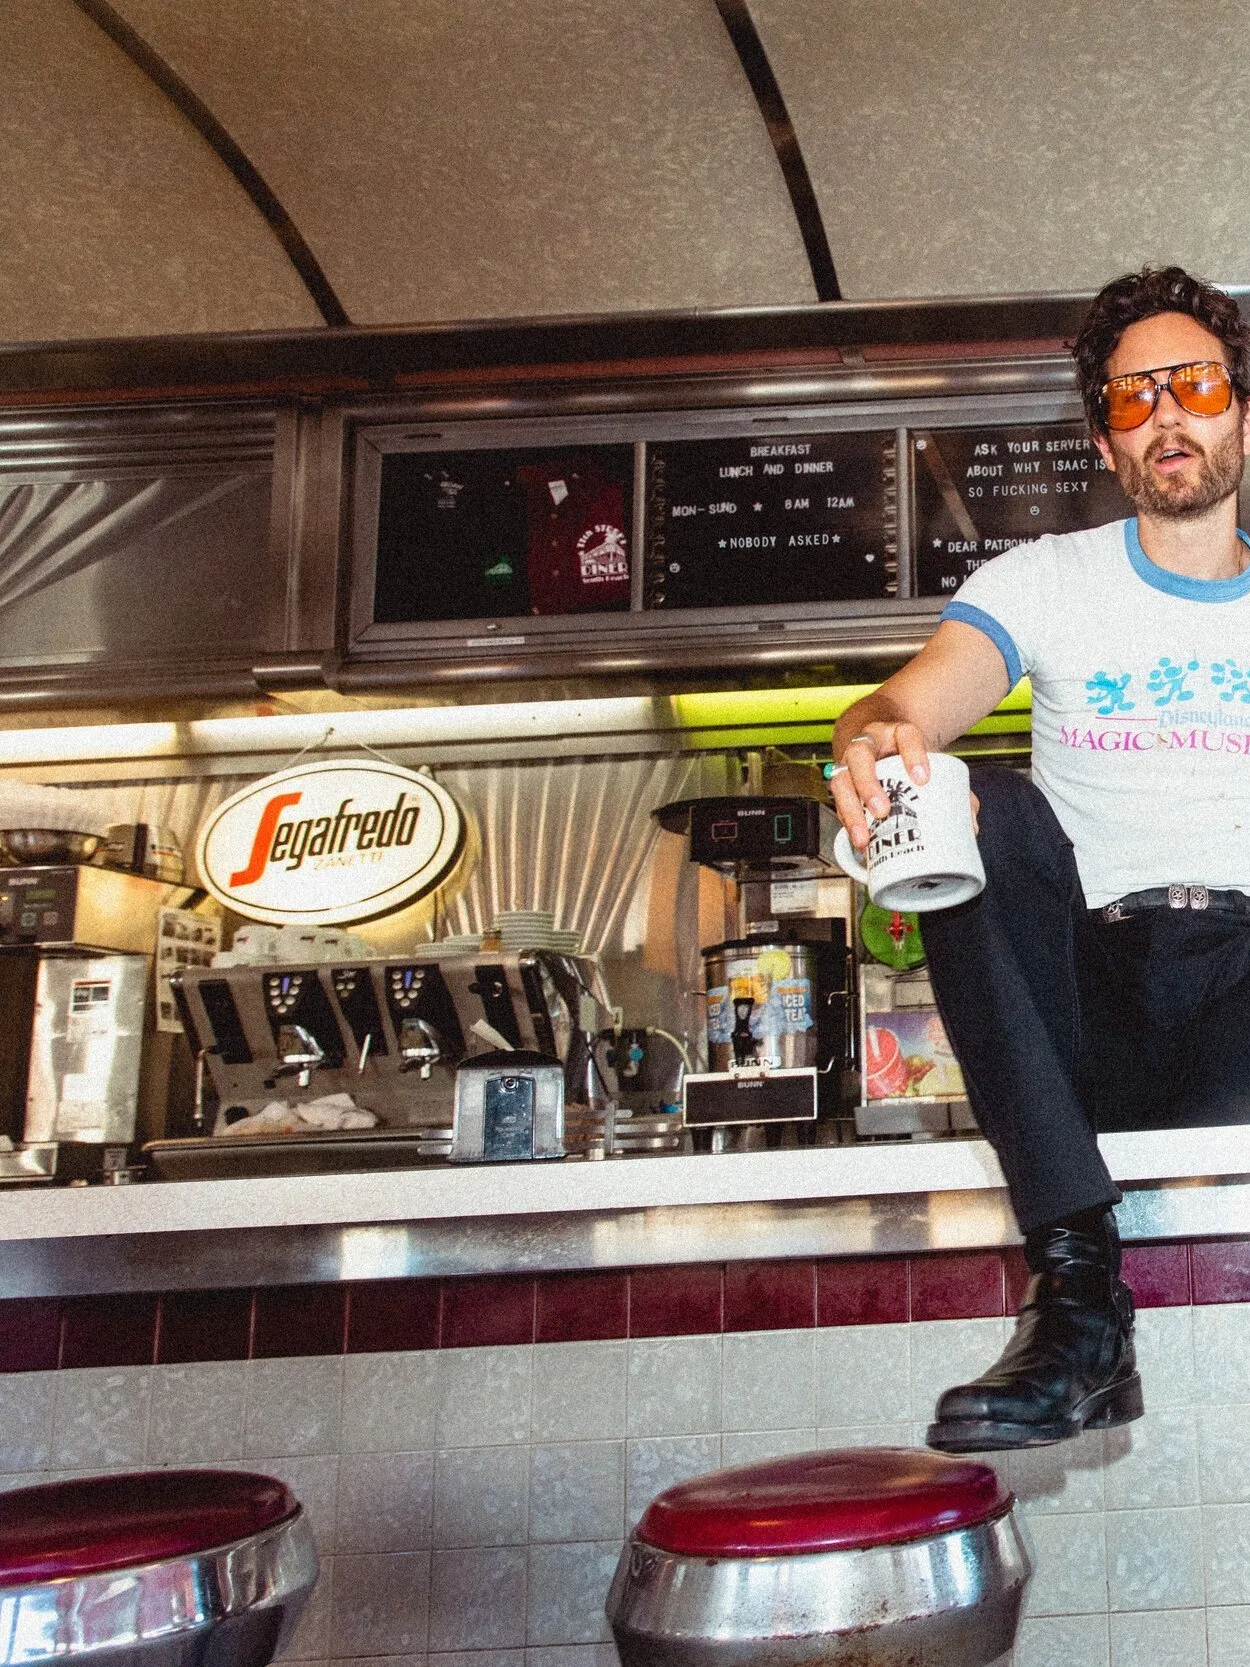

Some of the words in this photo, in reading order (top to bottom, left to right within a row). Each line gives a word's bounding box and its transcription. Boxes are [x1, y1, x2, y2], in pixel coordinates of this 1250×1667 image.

[750, 444, 811, 458] BREAKFAST
[974, 443, 998, 456] ASK
[1007, 440, 1040, 453] YOUR
[1046, 439, 1091, 452] SERVER
[719, 465, 754, 479] LUNCH
[763, 464, 784, 475] AND
[795, 462, 833, 474] DINNER
[966, 464, 1003, 478] ABOUT
[1013, 461, 1040, 473] WHY
[1052, 459, 1088, 472] ISAAC
[968, 487, 983, 498] SO
[993, 483, 1048, 497] FUCKING
[1055, 481, 1089, 493] SEXY
[827, 497, 855, 509] 12AM
[730, 536, 777, 549] NOBODY
[788, 534, 830, 547] ASKED
[948, 541, 977, 553] DEAR
[581, 562, 629, 577] DINER
[941, 576, 957, 588] NO
[1059, 725, 1156, 752] MAGIC
[229, 791, 421, 888] Segafredo
[782, 994, 805, 1008] ICED
[785, 1007, 804, 1022] TEA
[737, 1081, 764, 1089] BUNN
